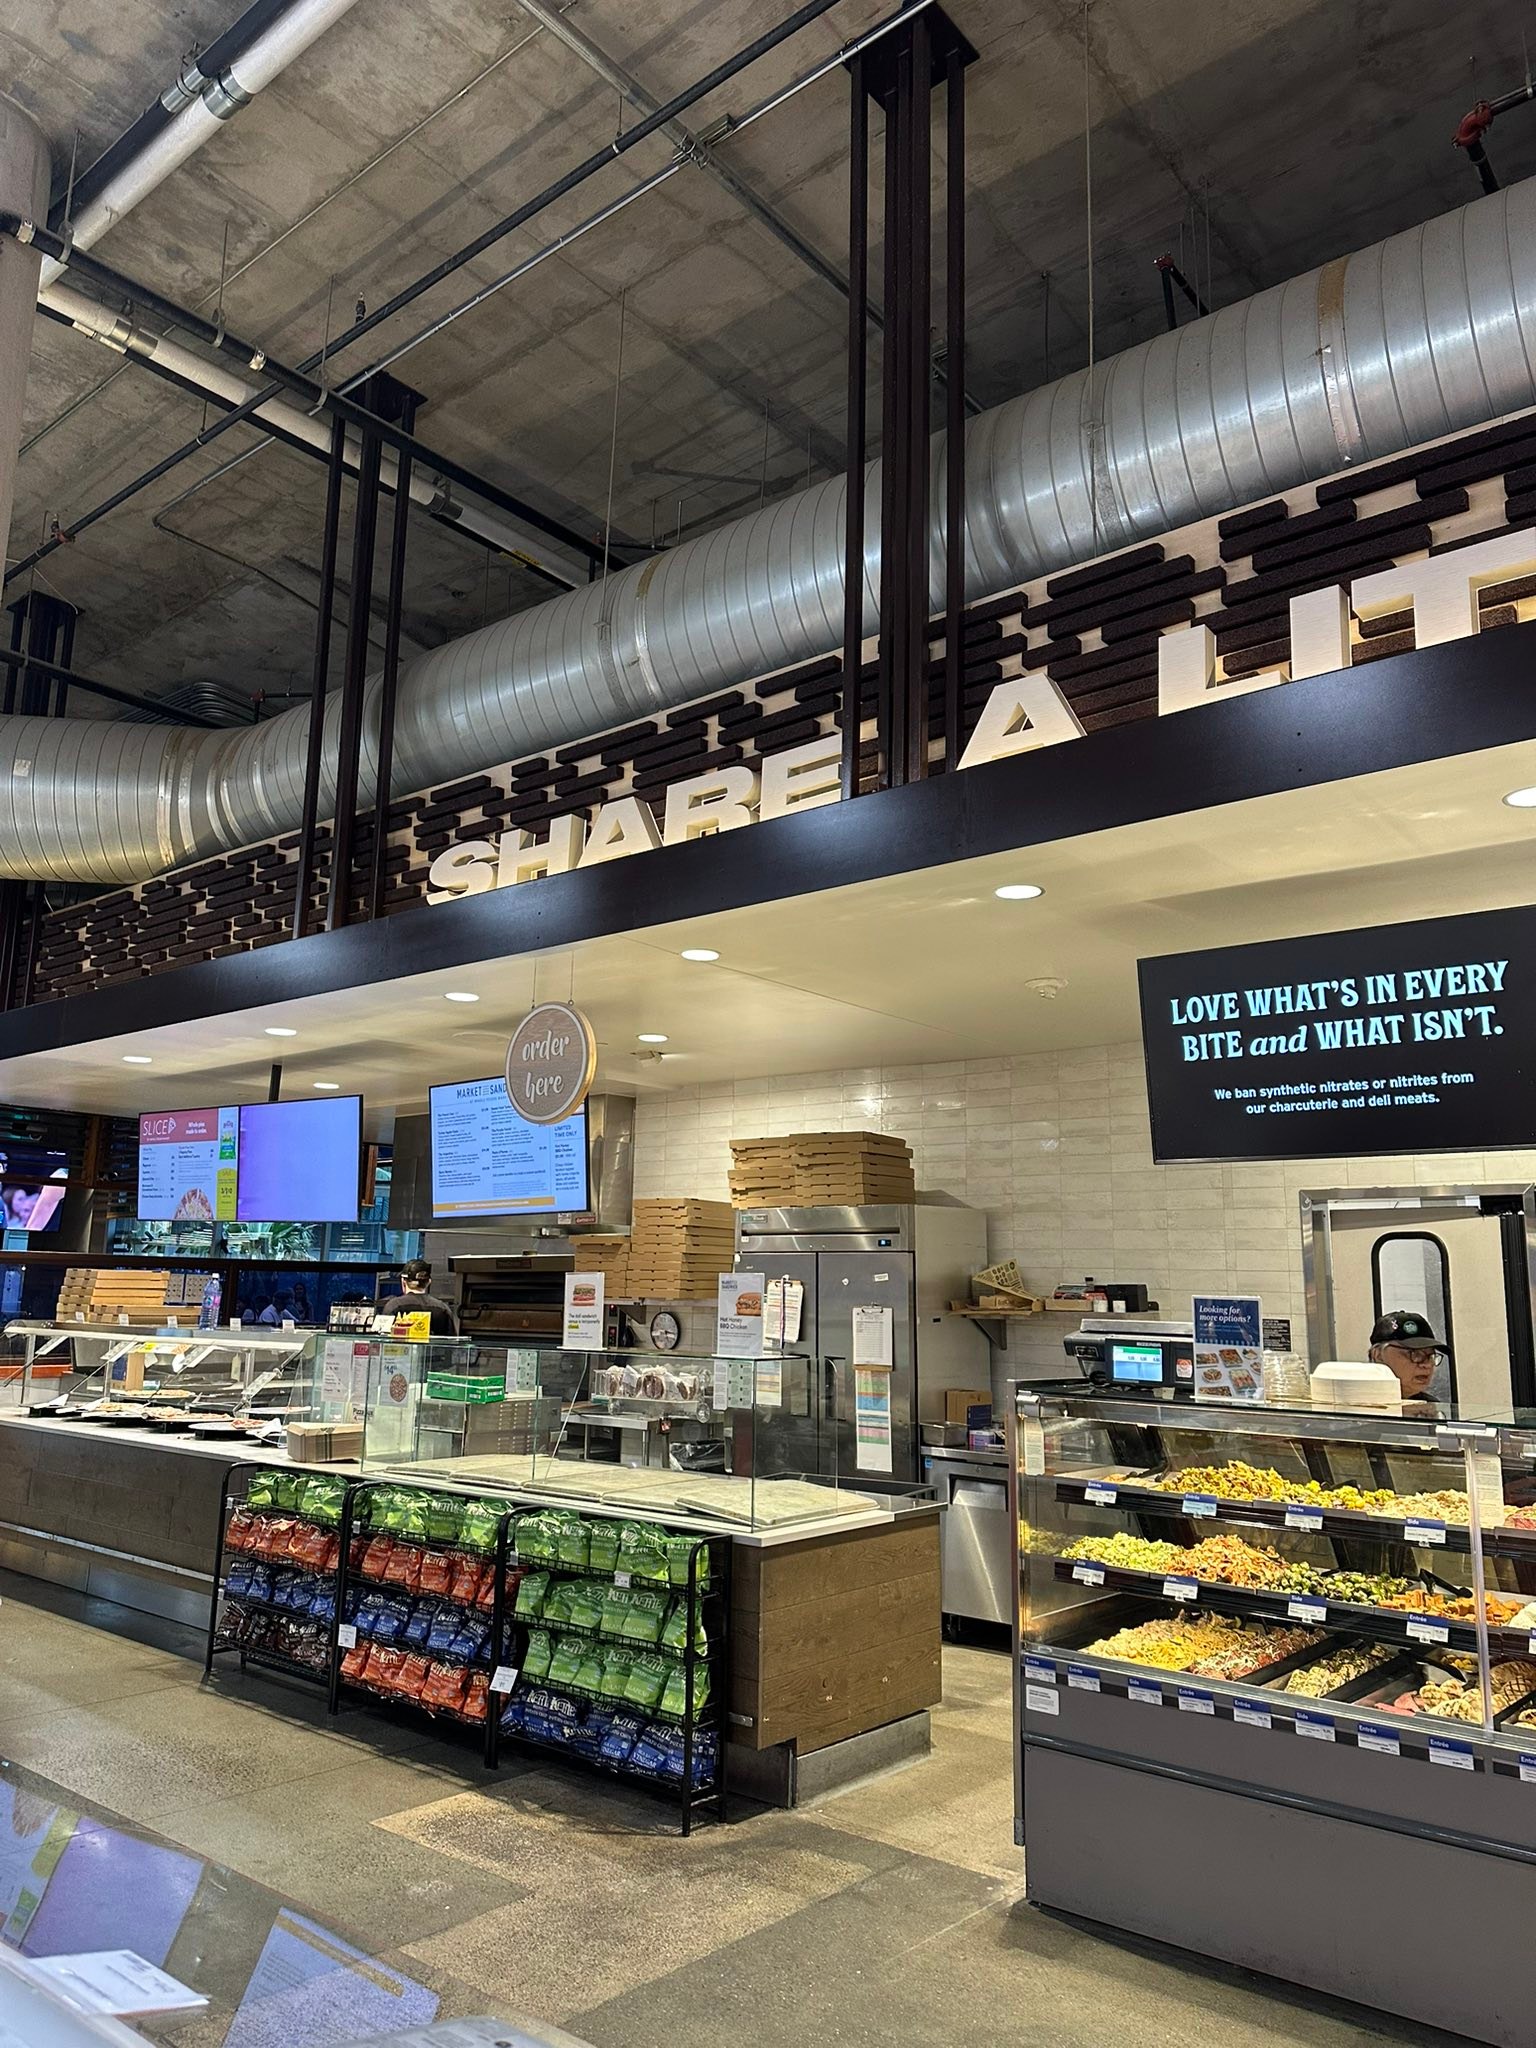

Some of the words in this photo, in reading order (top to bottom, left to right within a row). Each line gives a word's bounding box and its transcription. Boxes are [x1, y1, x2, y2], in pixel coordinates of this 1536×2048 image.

[427, 730, 842, 905] SHARE
[956, 673, 1087, 770] A
[1170, 992, 1240, 1025] LOVE
[1244, 978, 1359, 1017] WHAT'S
[1365, 973, 1398, 1005] IN
[1404, 960, 1509, 1001] EVERY
[1181, 1030, 1243, 1062] BITE
[1250, 1025, 1308, 1056] and
[1314, 1014, 1405, 1050] WHAT
[1411, 1005, 1504, 1042] ISN'T.
[522, 1030, 569, 1061] order
[457, 1086, 482, 1099] MARKET
[525, 1072, 564, 1104] here
[1214, 1089, 1232, 1100] We
[1235, 1086, 1257, 1099] ban
[1260, 1083, 1316, 1100] synthetic
[1320, 1079, 1369, 1093] nitrates
[1372, 1080, 1386, 1089] or
[1389, 1075, 1438, 1089] nitrites
[1441, 1071, 1474, 1085] from
[1246, 1104, 1267, 1114] our
[1269, 1099, 1338, 1113] charcuterie
[1342, 1096, 1365, 1109] and
[1368, 1094, 1391, 1107] deli
[1394, 1092, 1441, 1105] meats.
[143, 1119, 168, 1136] SLICE
[1199, 1305, 1228, 1315] Looking
[1229, 1306, 1240, 1316] for
[1218, 1315, 1251, 1324] options?
[1296, 1711, 1308, 1720] Side
[1359, 1724, 1377, 1734] Entrée
[1430, 1738, 1449, 1748] Entrée
